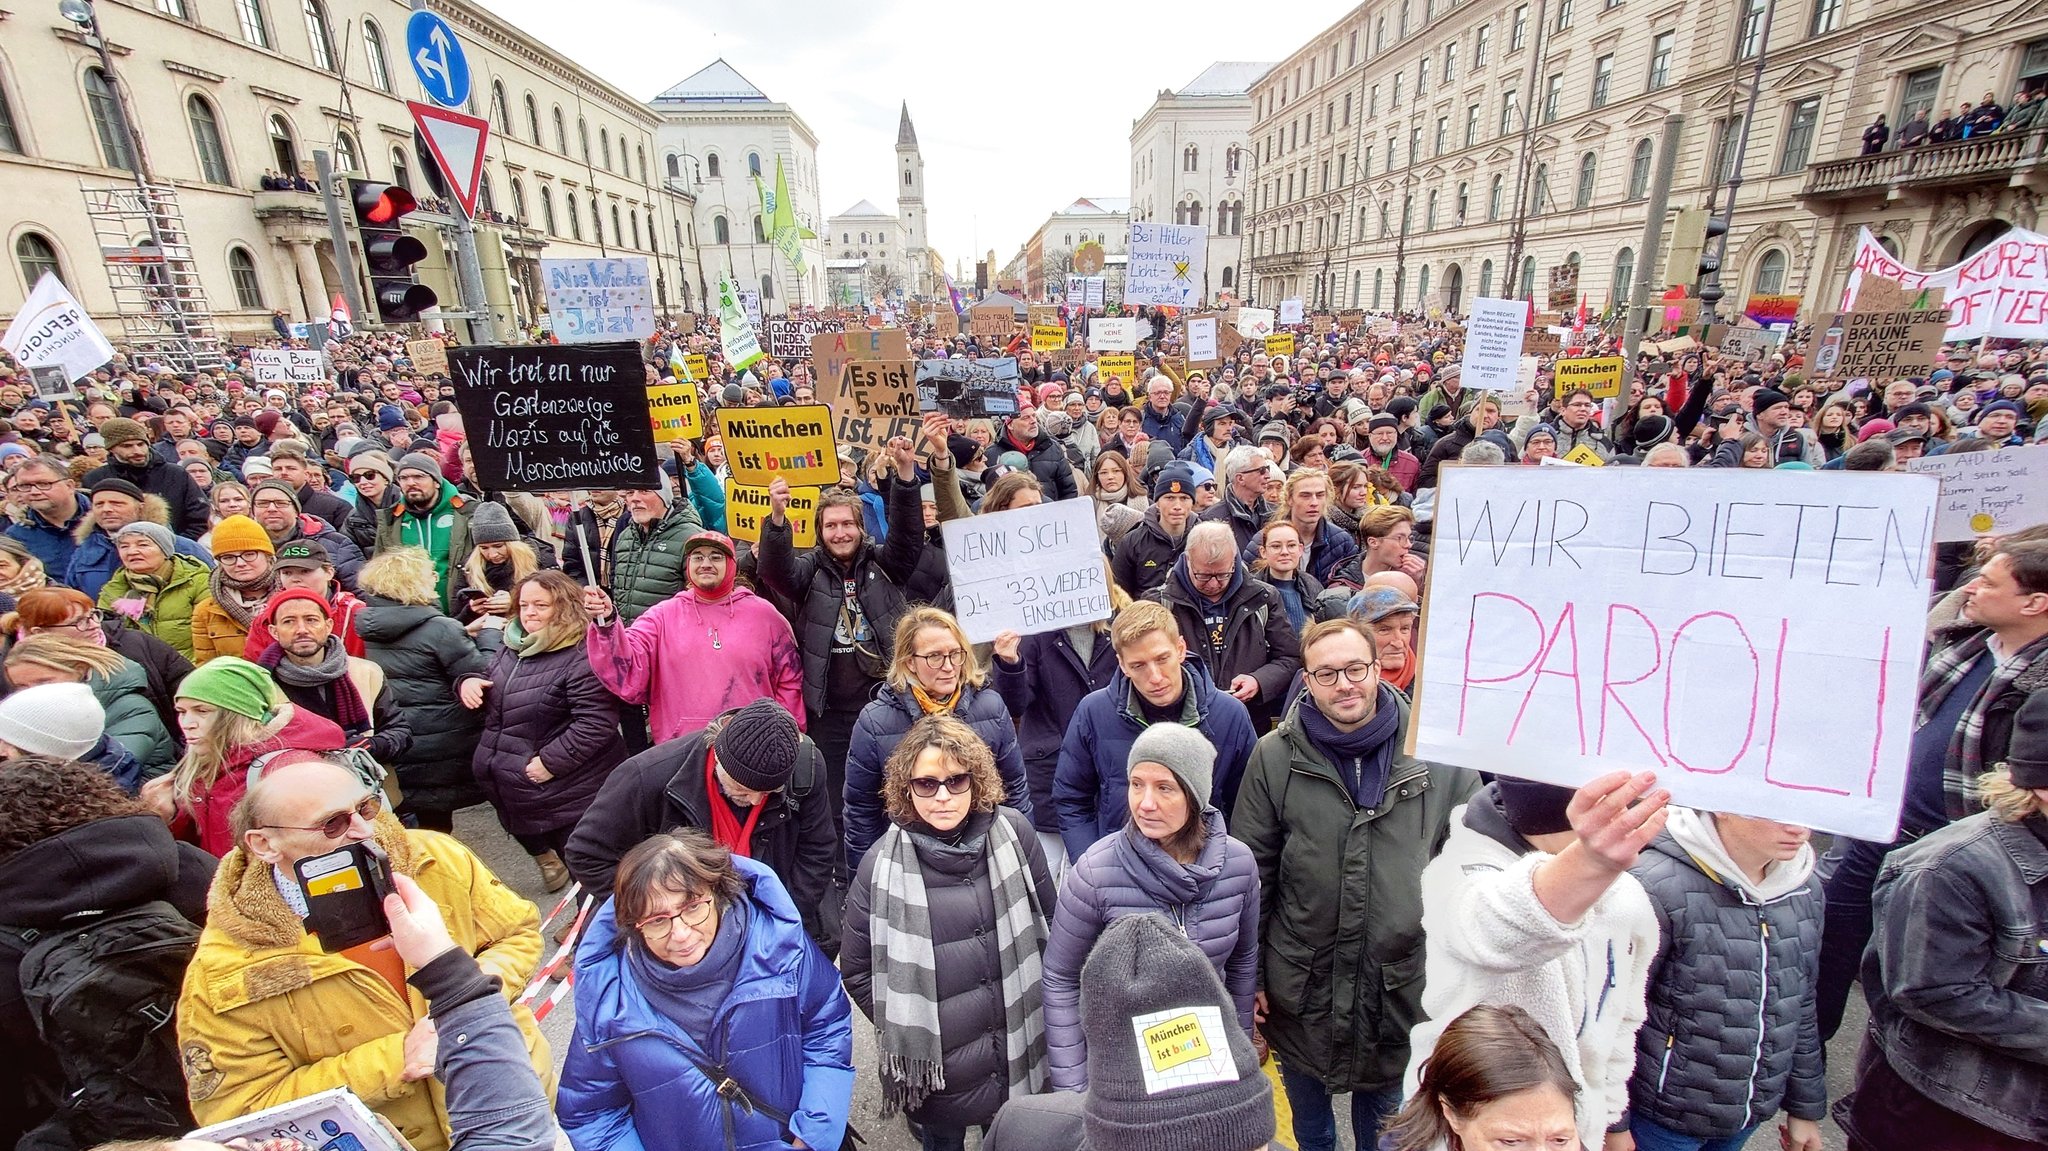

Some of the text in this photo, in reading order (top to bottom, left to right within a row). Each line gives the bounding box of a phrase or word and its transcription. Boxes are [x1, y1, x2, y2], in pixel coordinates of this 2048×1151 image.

[1132, 225, 1194, 246] Bei Hitler
[1132, 246, 1190, 262] brennt noch
[551, 262, 646, 290] Nie Wieder
[1130, 263, 1159, 278] Licht
[1128, 279, 1174, 294] drehen wir
[588, 289, 609, 307] ist
[1152, 288, 1190, 305] es ab!
[566, 306, 634, 336] Jetzt
[1852, 310, 1950, 326] DIE EINZIGE
[772, 323, 783, 333] Ob
[784, 322, 804, 332] OST
[814, 321, 840, 334] WEST
[1848, 326, 1911, 340] BRAUNE
[773, 334, 807, 344] NIEDER
[1844, 340, 1924, 353] FLASCHE,
[253, 351, 316, 364] Kein Bier
[1100, 359, 1132, 367] München
[1841, 354, 1896, 365] DIE ICH
[259, 366, 321, 381] für Nazis!
[457, 356, 502, 388] Wir
[508, 356, 572, 384] treten
[581, 364, 616, 383] nur
[851, 366, 877, 387] Es
[882, 365, 908, 389] ist
[1560, 364, 1617, 375] München
[1836, 364, 1929, 377] AKZEPTIERE
[1562, 382, 1576, 391] ist
[494, 390, 614, 420] Gartenzwerge
[650, 394, 692, 408] nchen
[856, 391, 870, 415] 5
[652, 414, 692, 430] bunt!
[728, 419, 823, 438] München
[838, 409, 872, 442] ist
[488, 419, 622, 454] Nazis auf die
[506, 450, 645, 482] Menschenwürde
[737, 449, 823, 471] ist bunt!
[1910, 451, 2013, 472] Wenn AfD die
[1974, 471, 1999, 480] sein
[2008, 467, 2028, 477] soll
[732, 489, 812, 509] Münen
[1948, 494, 2024, 514] die Frage?
[736, 513, 755, 529] ist
[282, 546, 310, 557] ASS
[949, 520, 1069, 566] WENN SICH
[1456, 498, 1930, 588] WIR BIETEN
[1040, 566, 1102, 597] WIEDER
[1022, 594, 1109, 627] EINSCHLEICHT
[1457, 591, 1892, 798] PAROLI
[1150, 1022, 1197, 1044] München
[1157, 1037, 1201, 1060] ist bunt!
